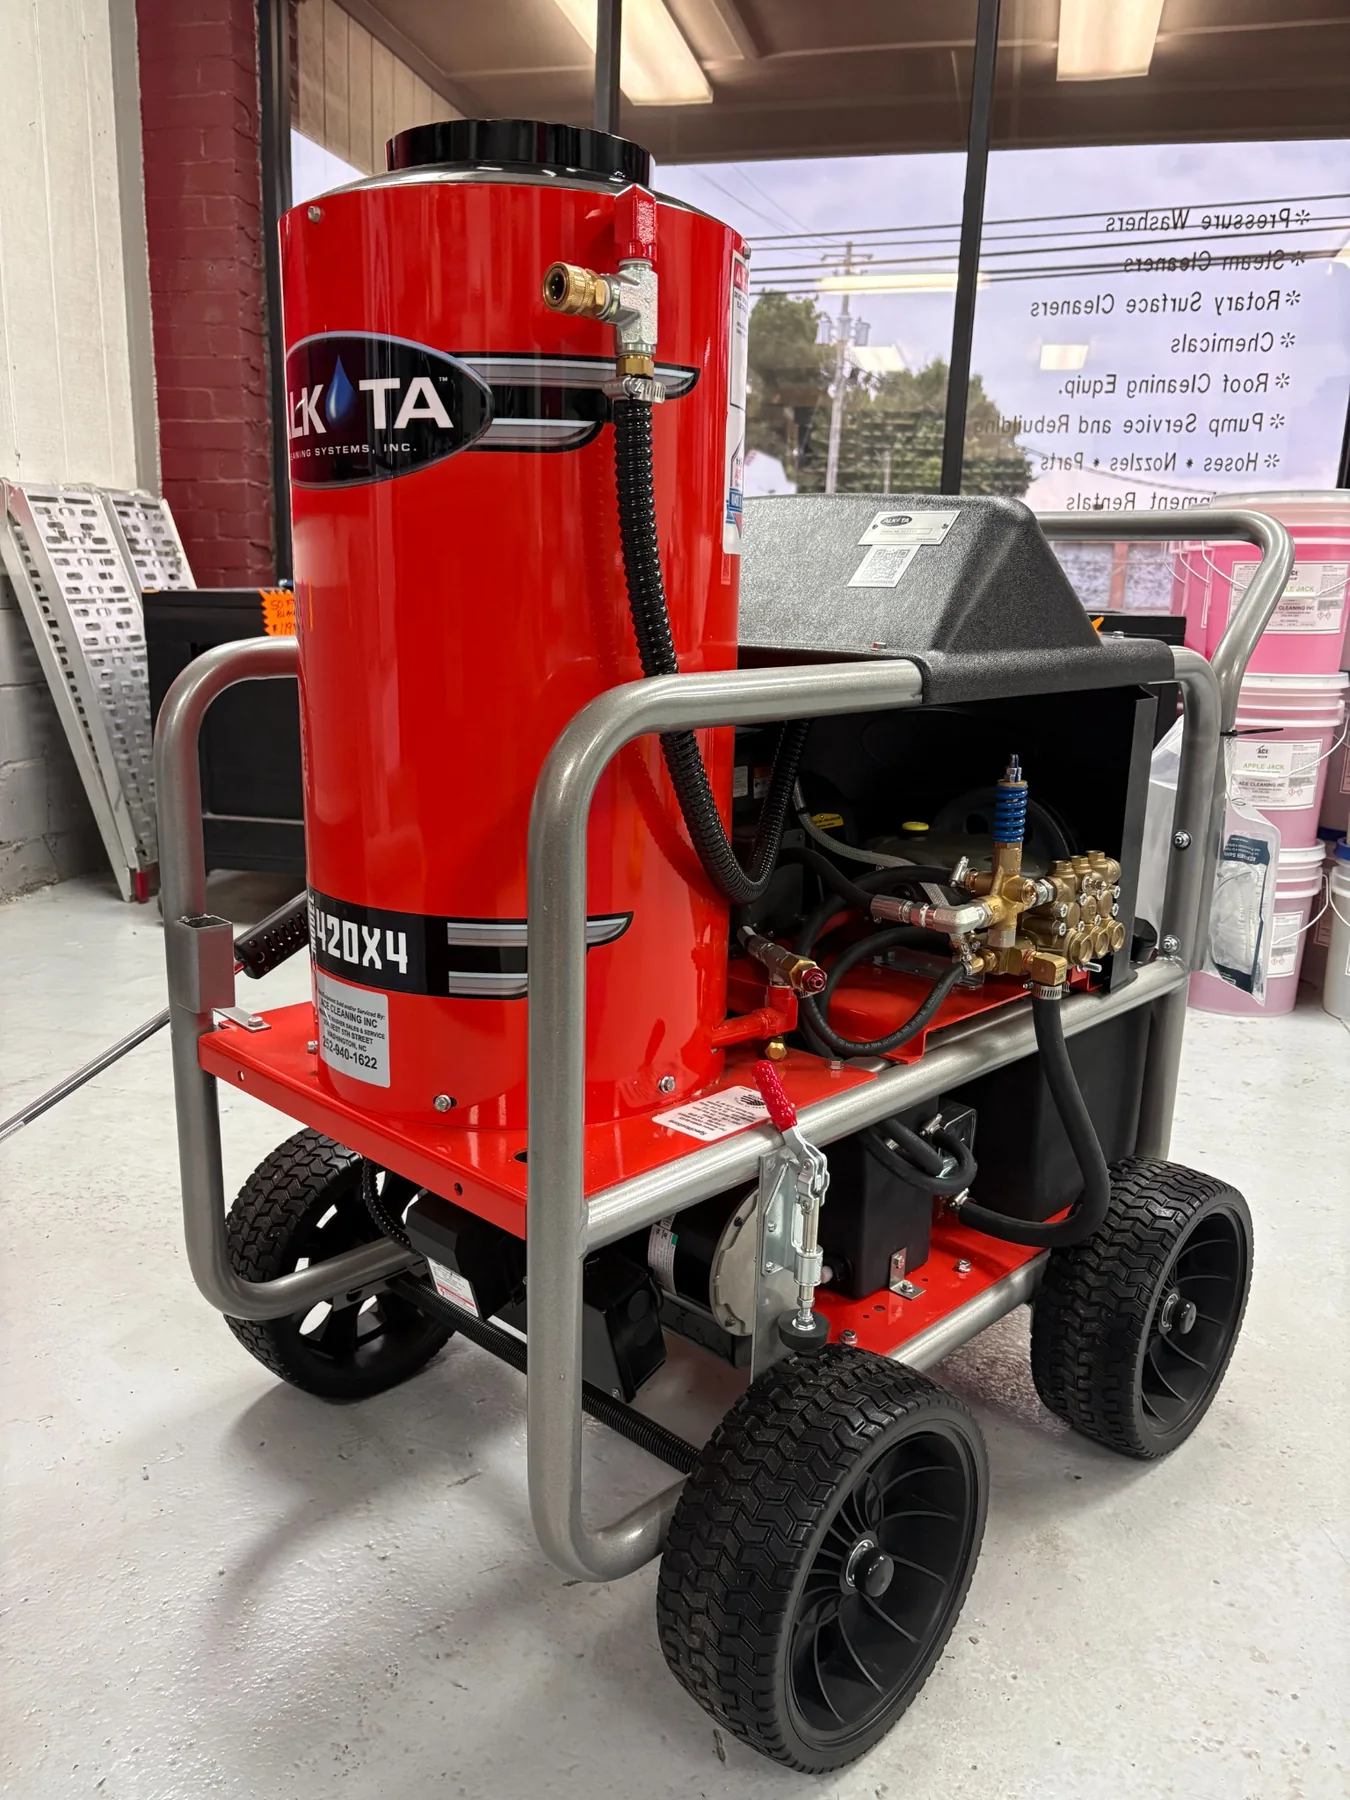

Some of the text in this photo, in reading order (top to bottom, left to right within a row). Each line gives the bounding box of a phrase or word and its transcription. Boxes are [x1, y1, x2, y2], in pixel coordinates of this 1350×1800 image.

[315, 444, 376, 457] SYSTEMS,
[383, 443, 418, 453] INC.
[316, 907, 408, 974] 420X4
[330, 1004, 362, 1024] CLEANING
[363, 1017, 378, 1029] INC
[323, 1035, 378, 1070] 252-940-1622
